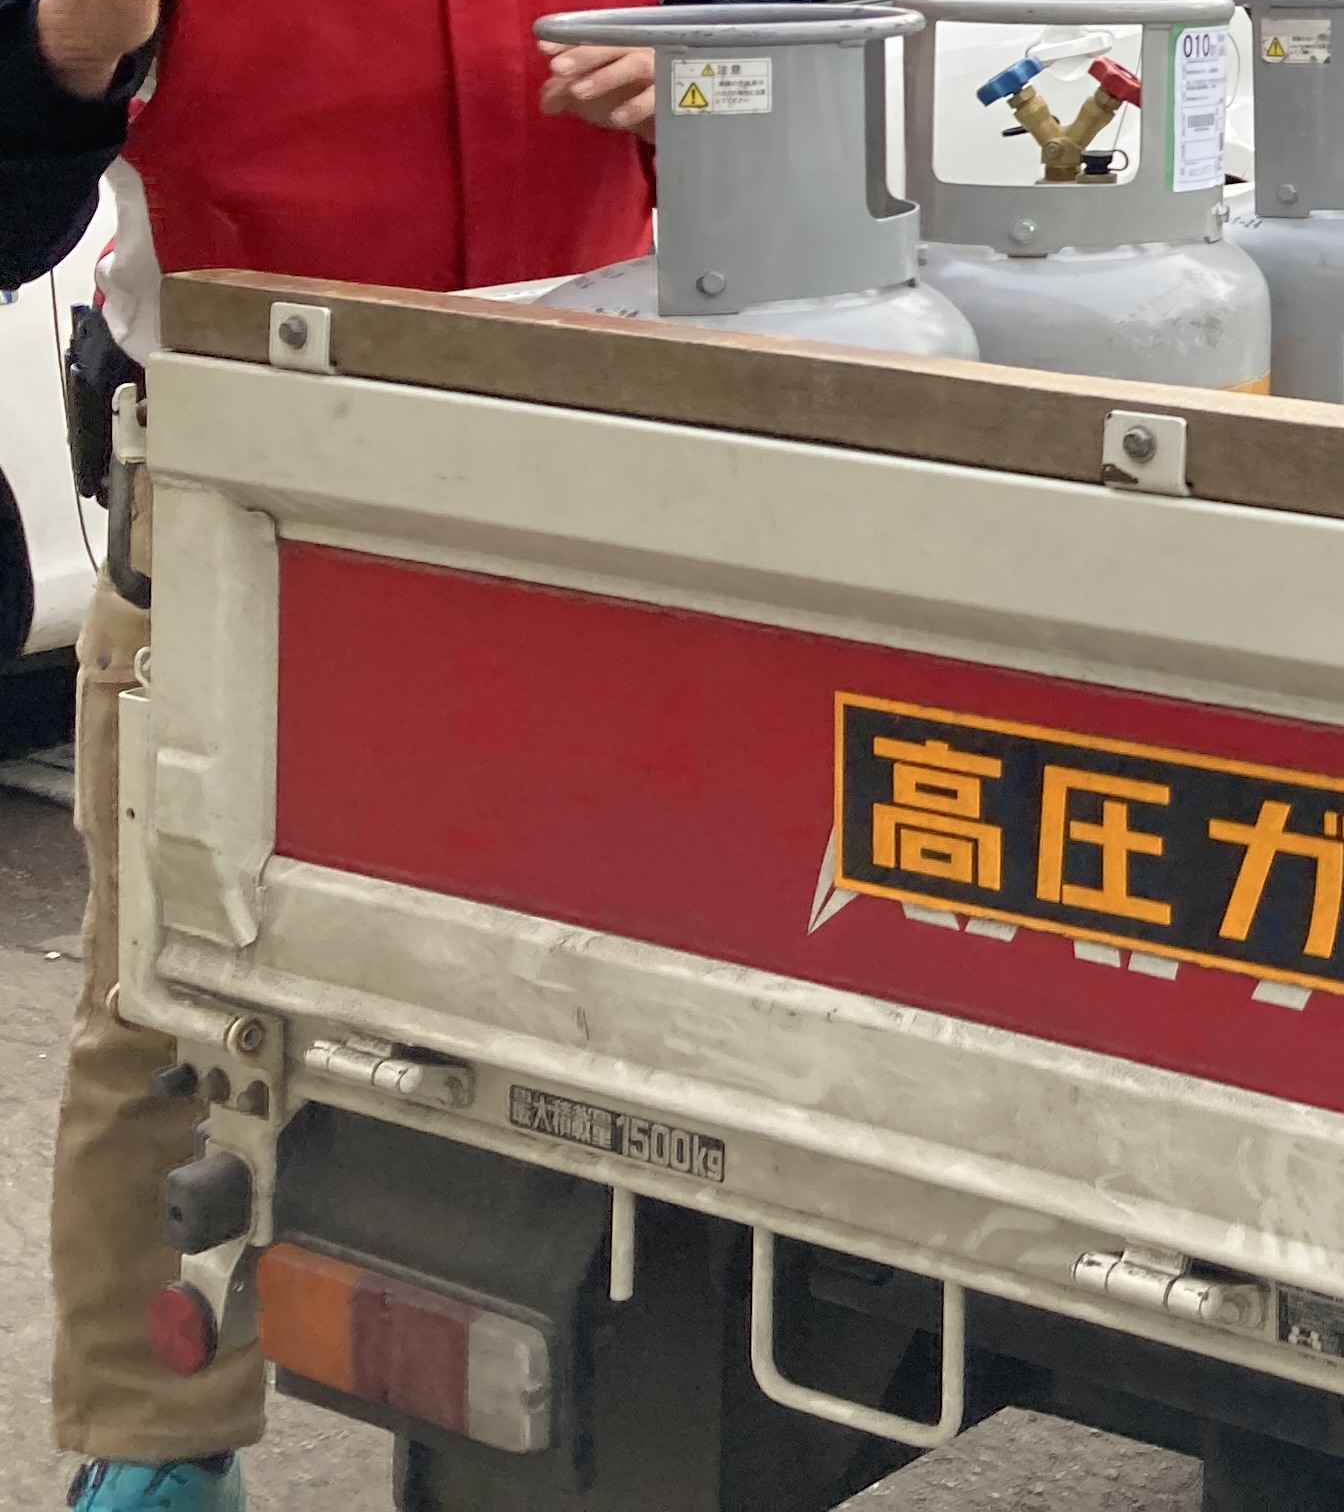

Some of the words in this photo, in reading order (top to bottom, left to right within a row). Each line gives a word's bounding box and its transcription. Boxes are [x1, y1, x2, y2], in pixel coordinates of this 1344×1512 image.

[1183, 34, 1210, 58] 010
[513, 1087, 612, 1150] 最大積載量
[615, 1113, 724, 1182] 1500kg
